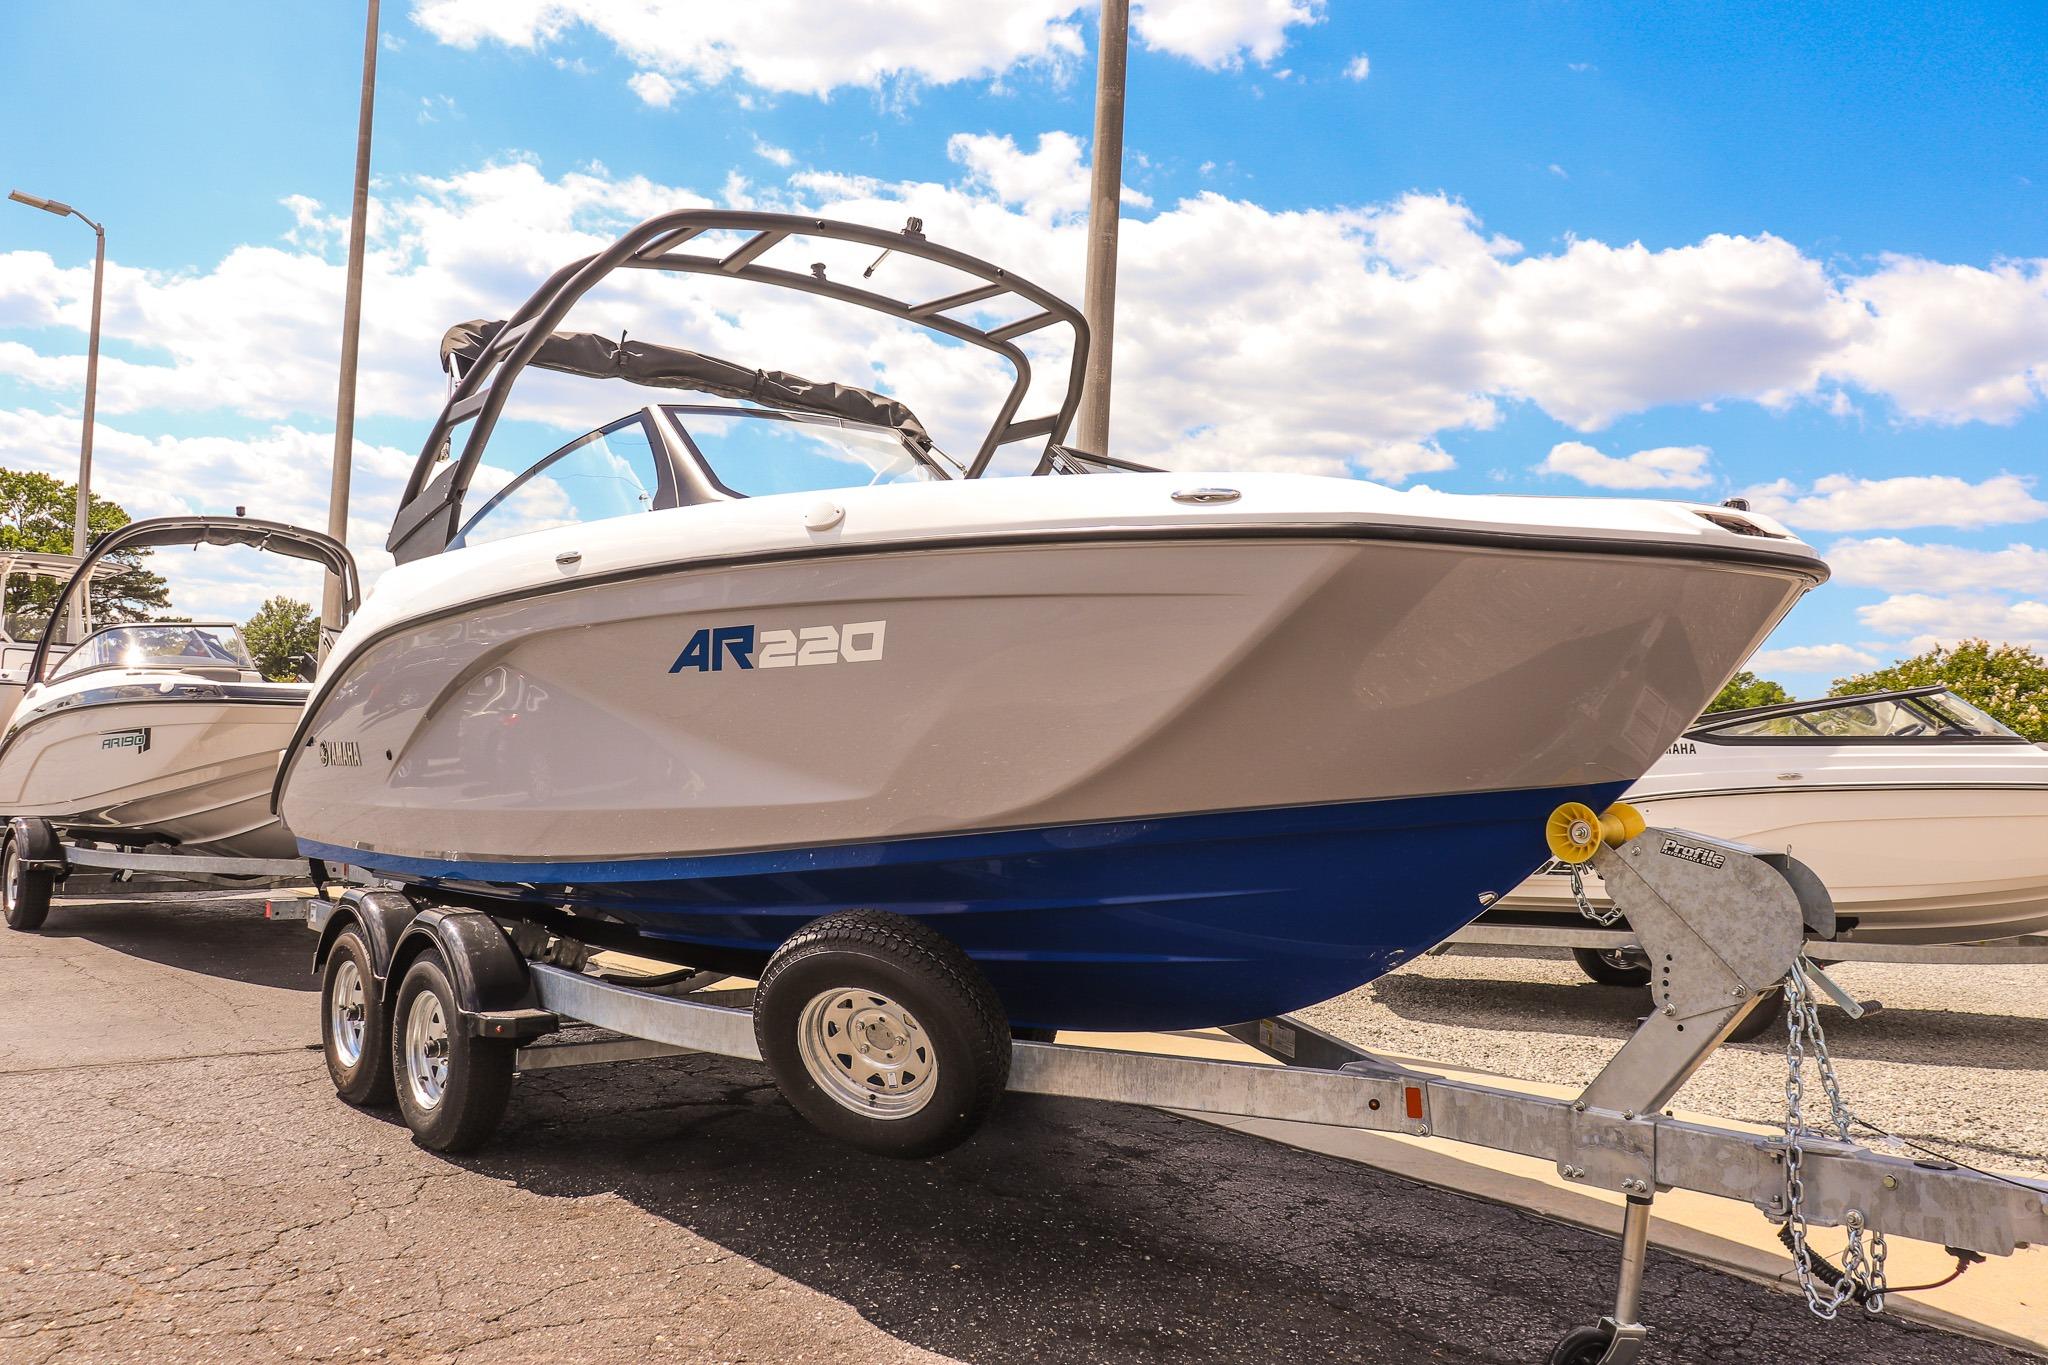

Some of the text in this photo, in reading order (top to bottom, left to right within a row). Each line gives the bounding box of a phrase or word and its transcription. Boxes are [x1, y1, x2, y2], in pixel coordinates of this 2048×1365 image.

[668, 620, 886, 673] AR220
[102, 735, 144, 750] AR190
[327, 741, 362, 767] YAMAHA
[1661, 849, 1700, 863] PERFORMANCE
[1662, 839, 1725, 864] Profile
